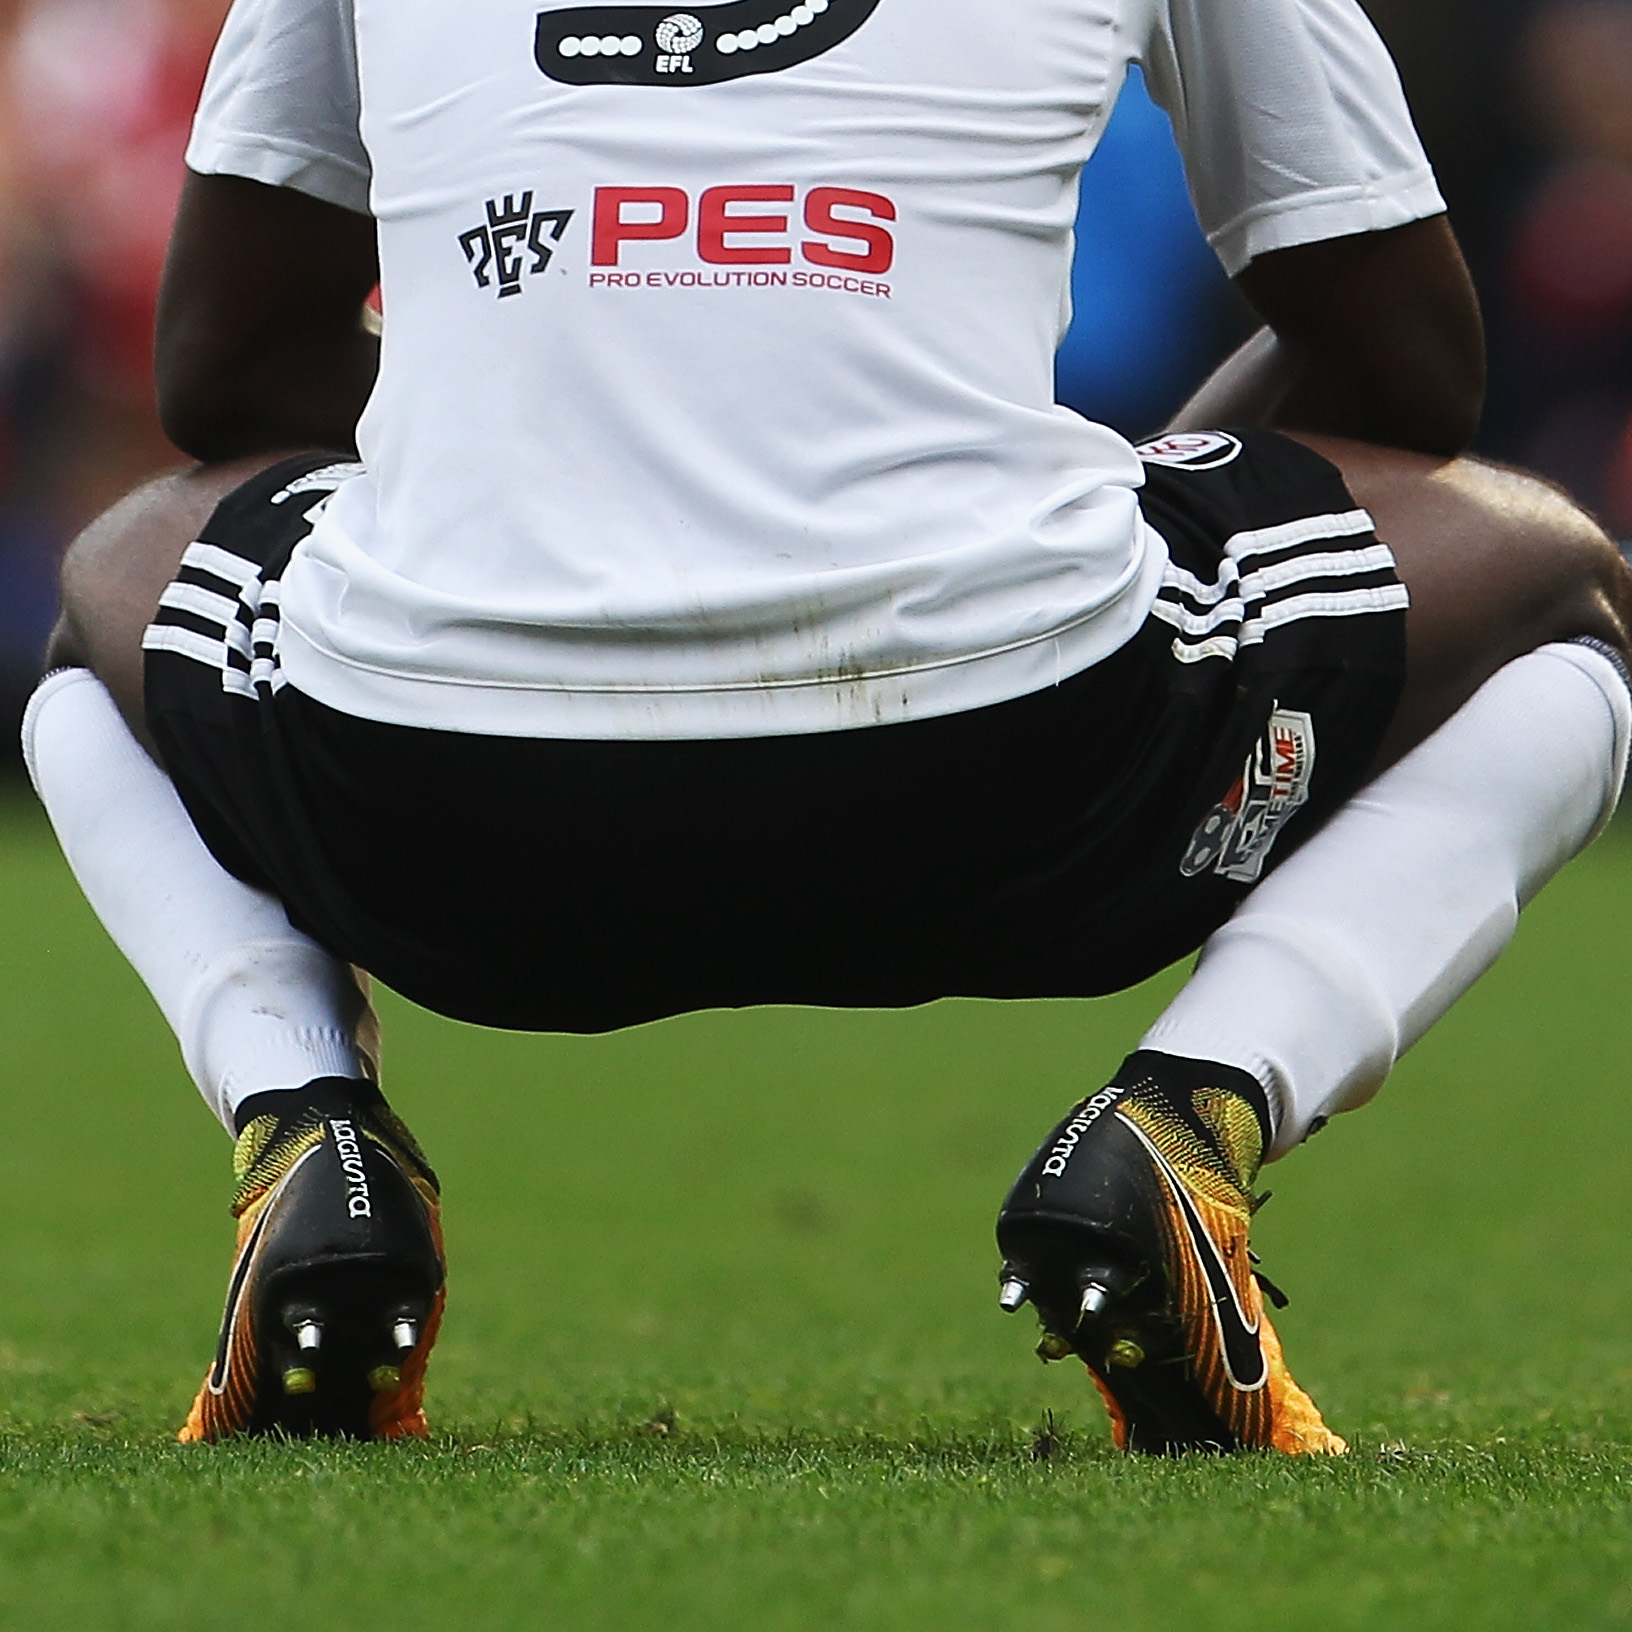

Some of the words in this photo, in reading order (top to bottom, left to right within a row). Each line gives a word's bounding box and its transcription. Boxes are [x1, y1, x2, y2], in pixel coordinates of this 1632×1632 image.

[655, 55, 693, 73] EFL
[590, 185, 896, 274] PES
[589, 272, 640, 287] PRO
[647, 271, 787, 287] EVOLUTION
[792, 272, 892, 299] SOCCER
